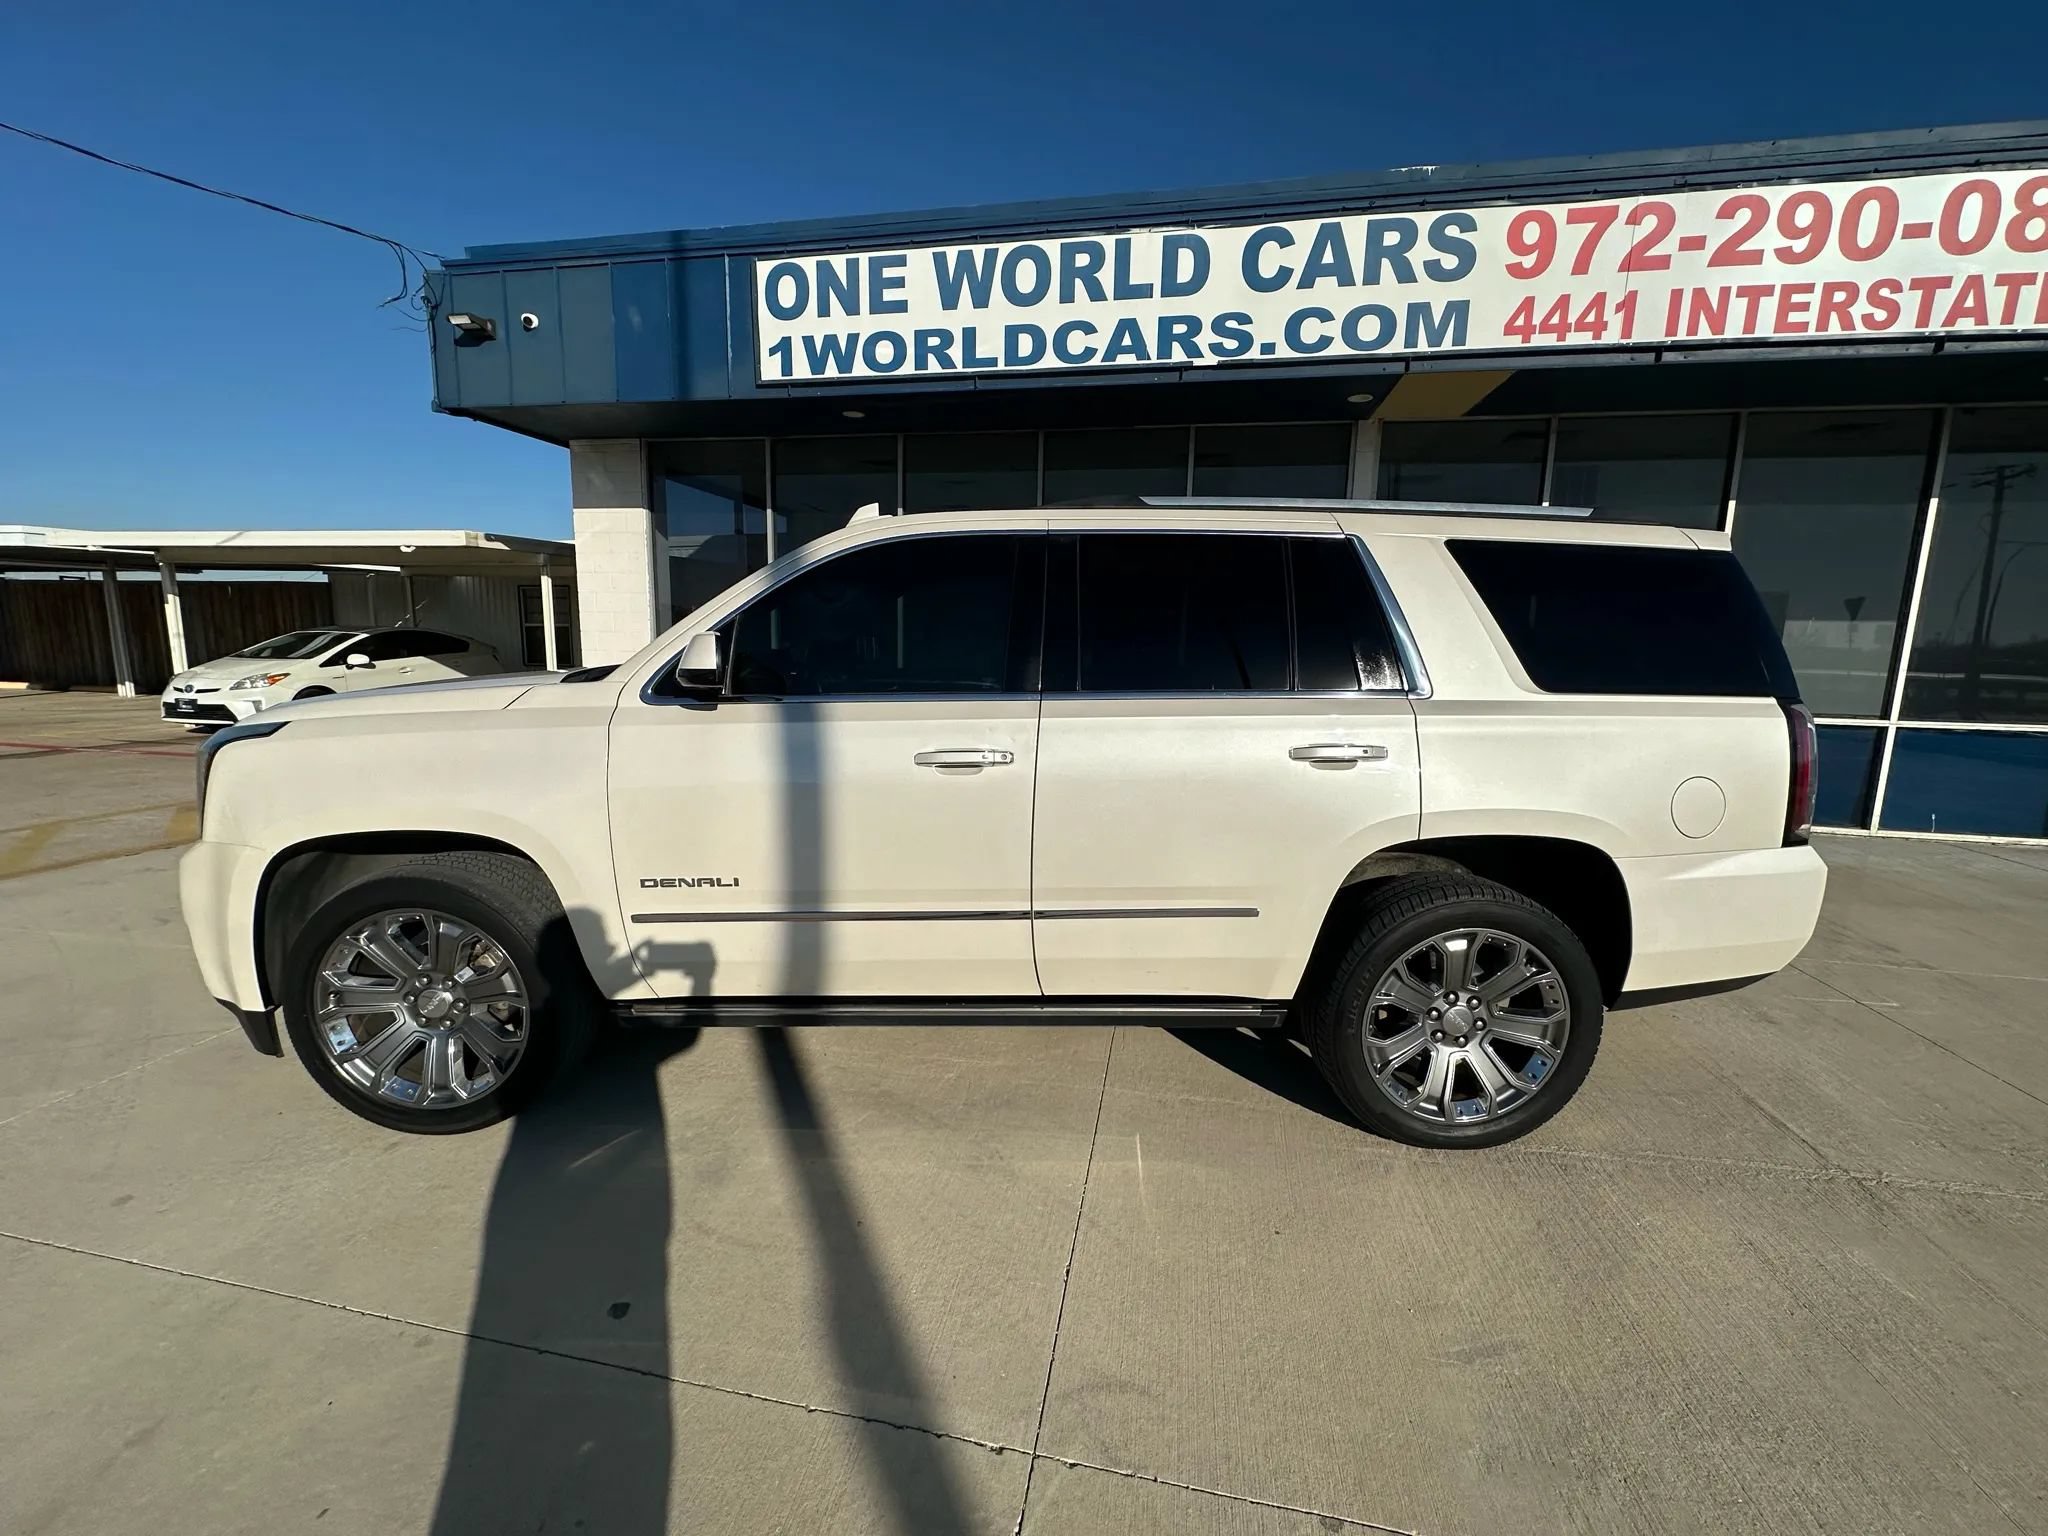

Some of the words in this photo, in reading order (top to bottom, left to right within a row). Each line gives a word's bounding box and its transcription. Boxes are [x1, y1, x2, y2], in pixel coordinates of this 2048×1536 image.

[764, 253, 909, 321] ONE
[932, 232, 1212, 312] WORLD
[1240, 211, 1479, 294] CARS
[767, 299, 1471, 378] 1WORLDCARS.COM
[1502, 289, 1638, 345] 4441
[639, 877, 740, 889] DENALI
